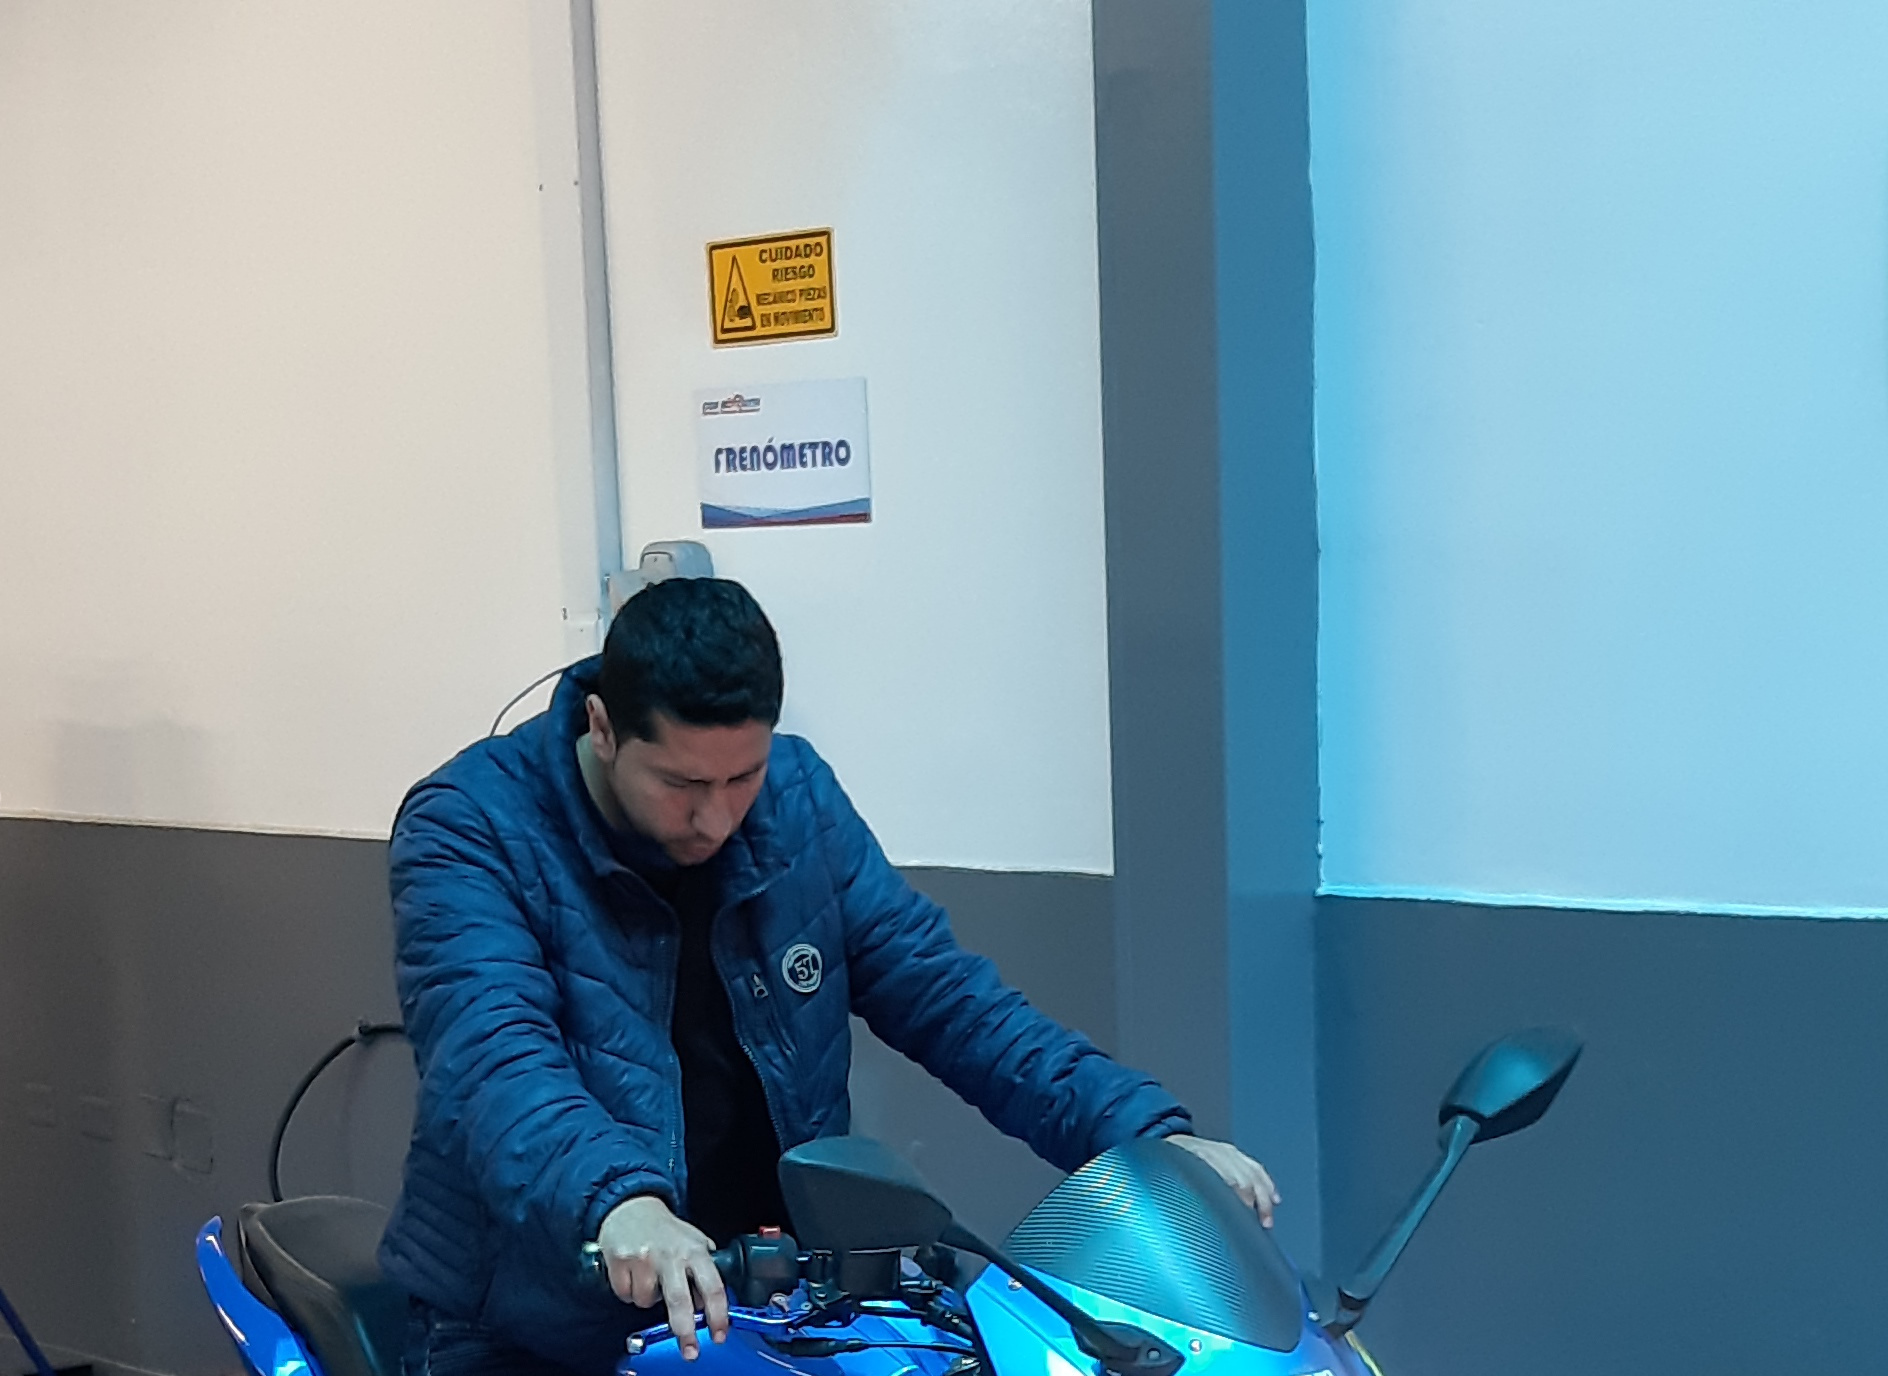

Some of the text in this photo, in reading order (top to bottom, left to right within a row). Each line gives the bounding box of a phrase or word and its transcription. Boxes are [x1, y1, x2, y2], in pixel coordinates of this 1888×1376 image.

[758, 241, 824, 264] CUIDADO
[772, 263, 816, 282] RIESGO
[714, 436, 852, 474] FRENÓMETRO
